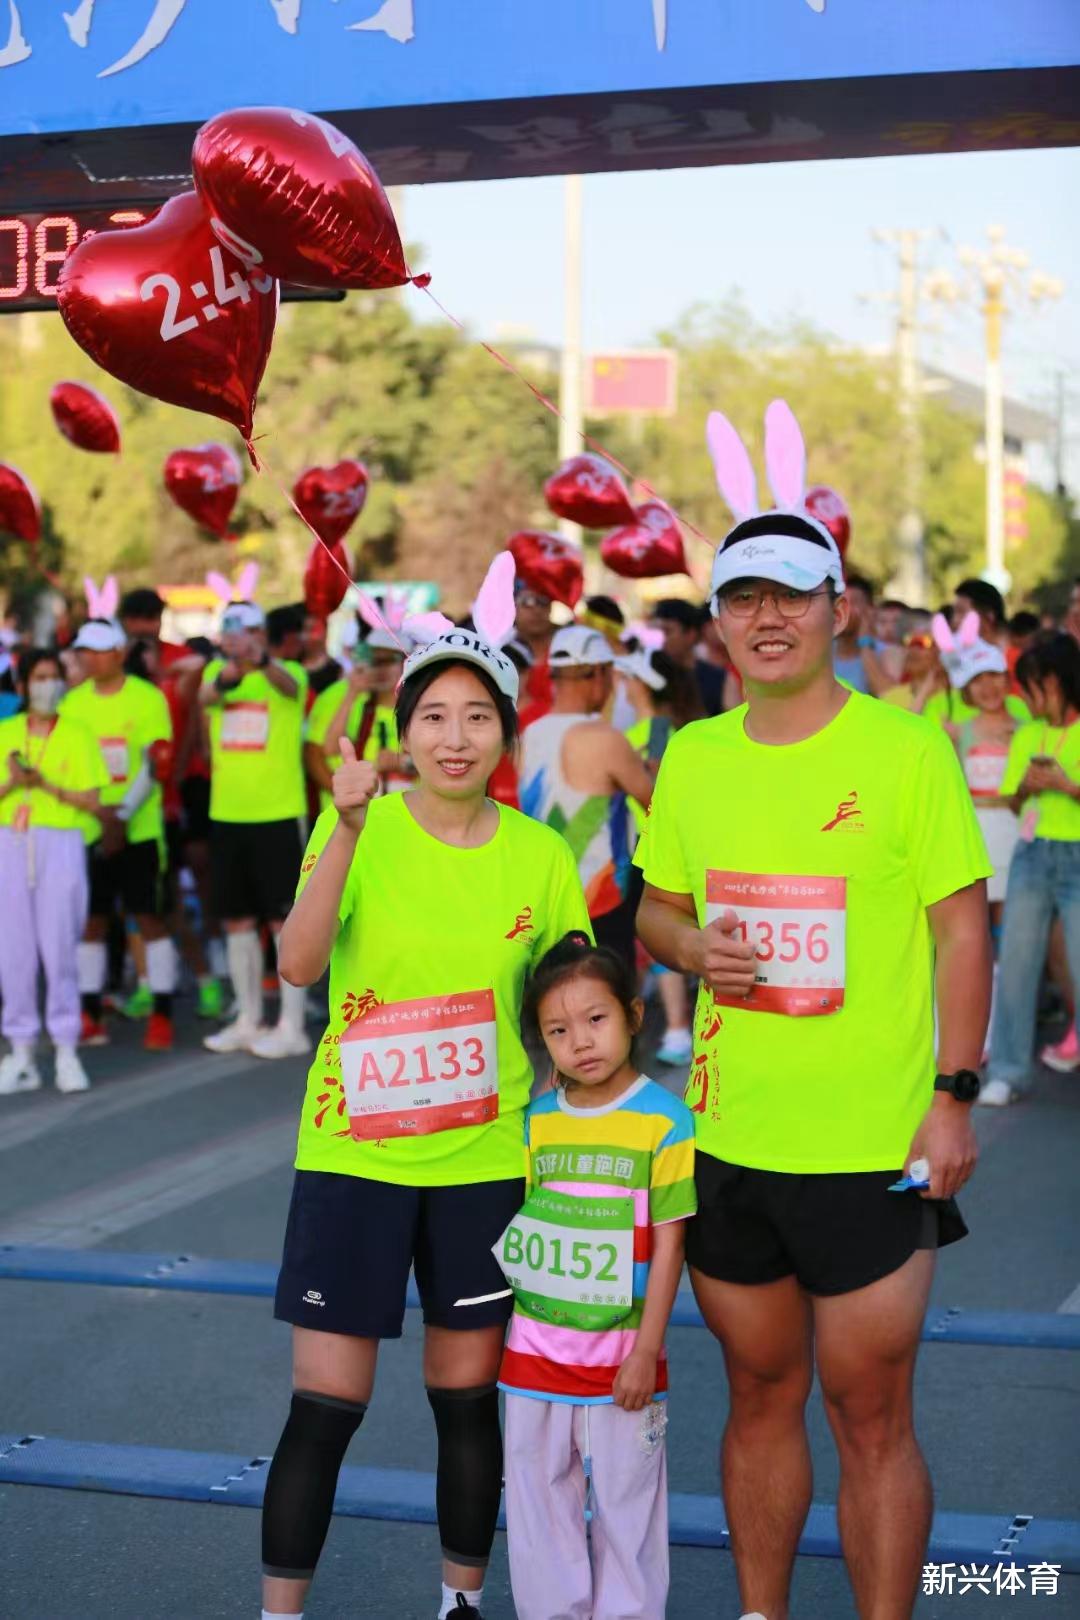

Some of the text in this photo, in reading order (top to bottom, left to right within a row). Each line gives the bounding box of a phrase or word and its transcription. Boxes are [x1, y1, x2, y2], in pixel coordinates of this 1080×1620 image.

[738, 919, 830, 965] 1356
[358, 1037, 486, 1092] A2133
[503, 1225, 619, 1282] B0152
